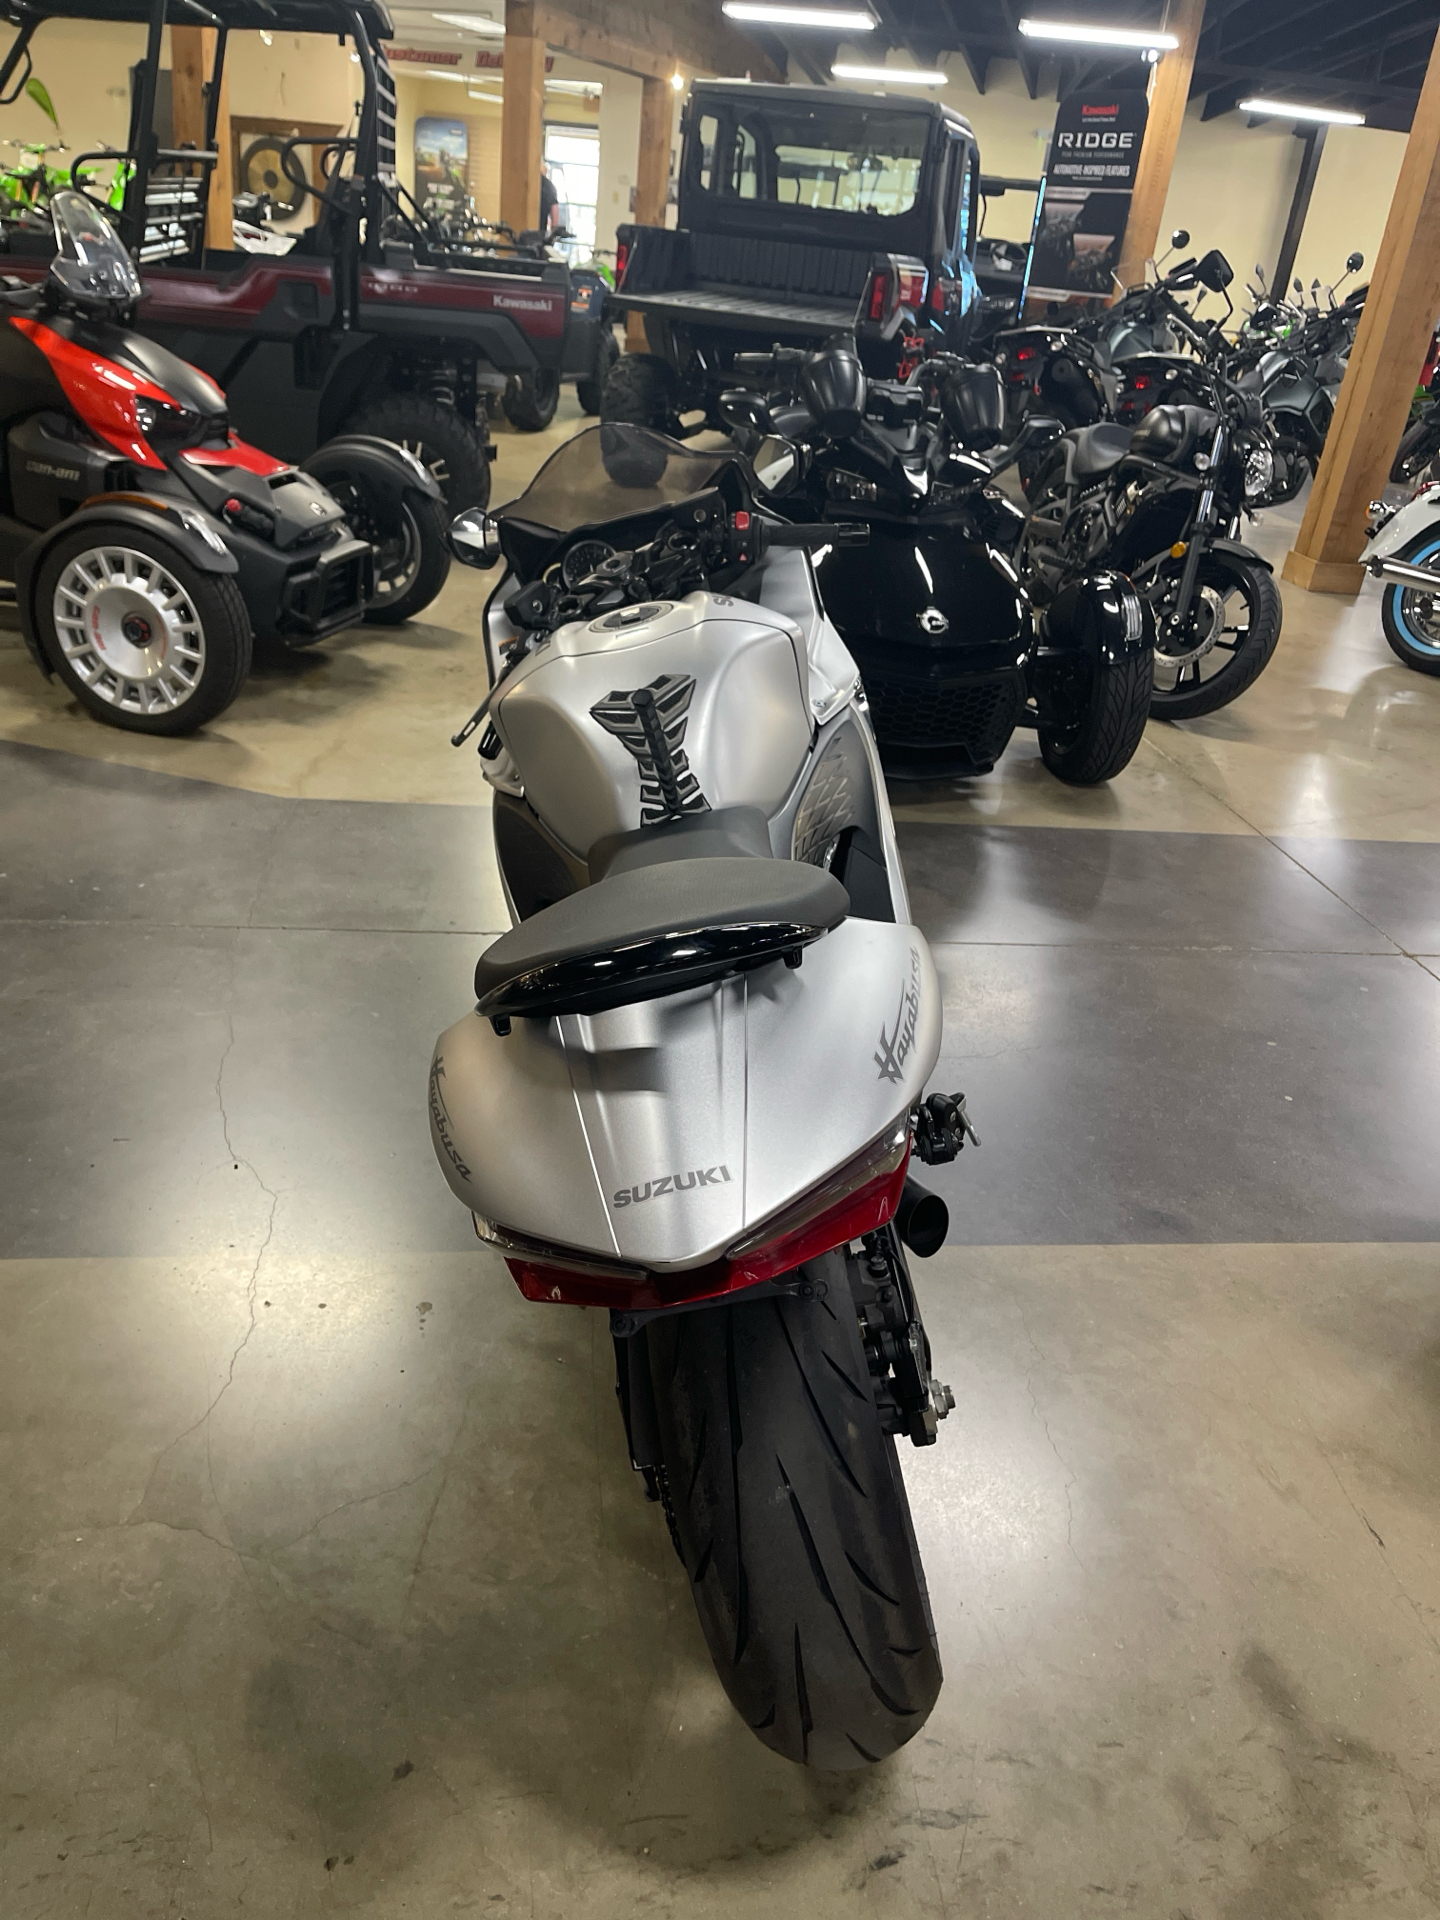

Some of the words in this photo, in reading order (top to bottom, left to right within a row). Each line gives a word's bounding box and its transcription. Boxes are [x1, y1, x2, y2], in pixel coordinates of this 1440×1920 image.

[384, 45, 462, 66] ustomer
[1058, 132, 1134, 149] RIDGE
[493, 294, 553, 312] Kawasaki
[873, 944, 922, 1085] Hayabusa
[613, 1165, 732, 1209] SUZUKI
